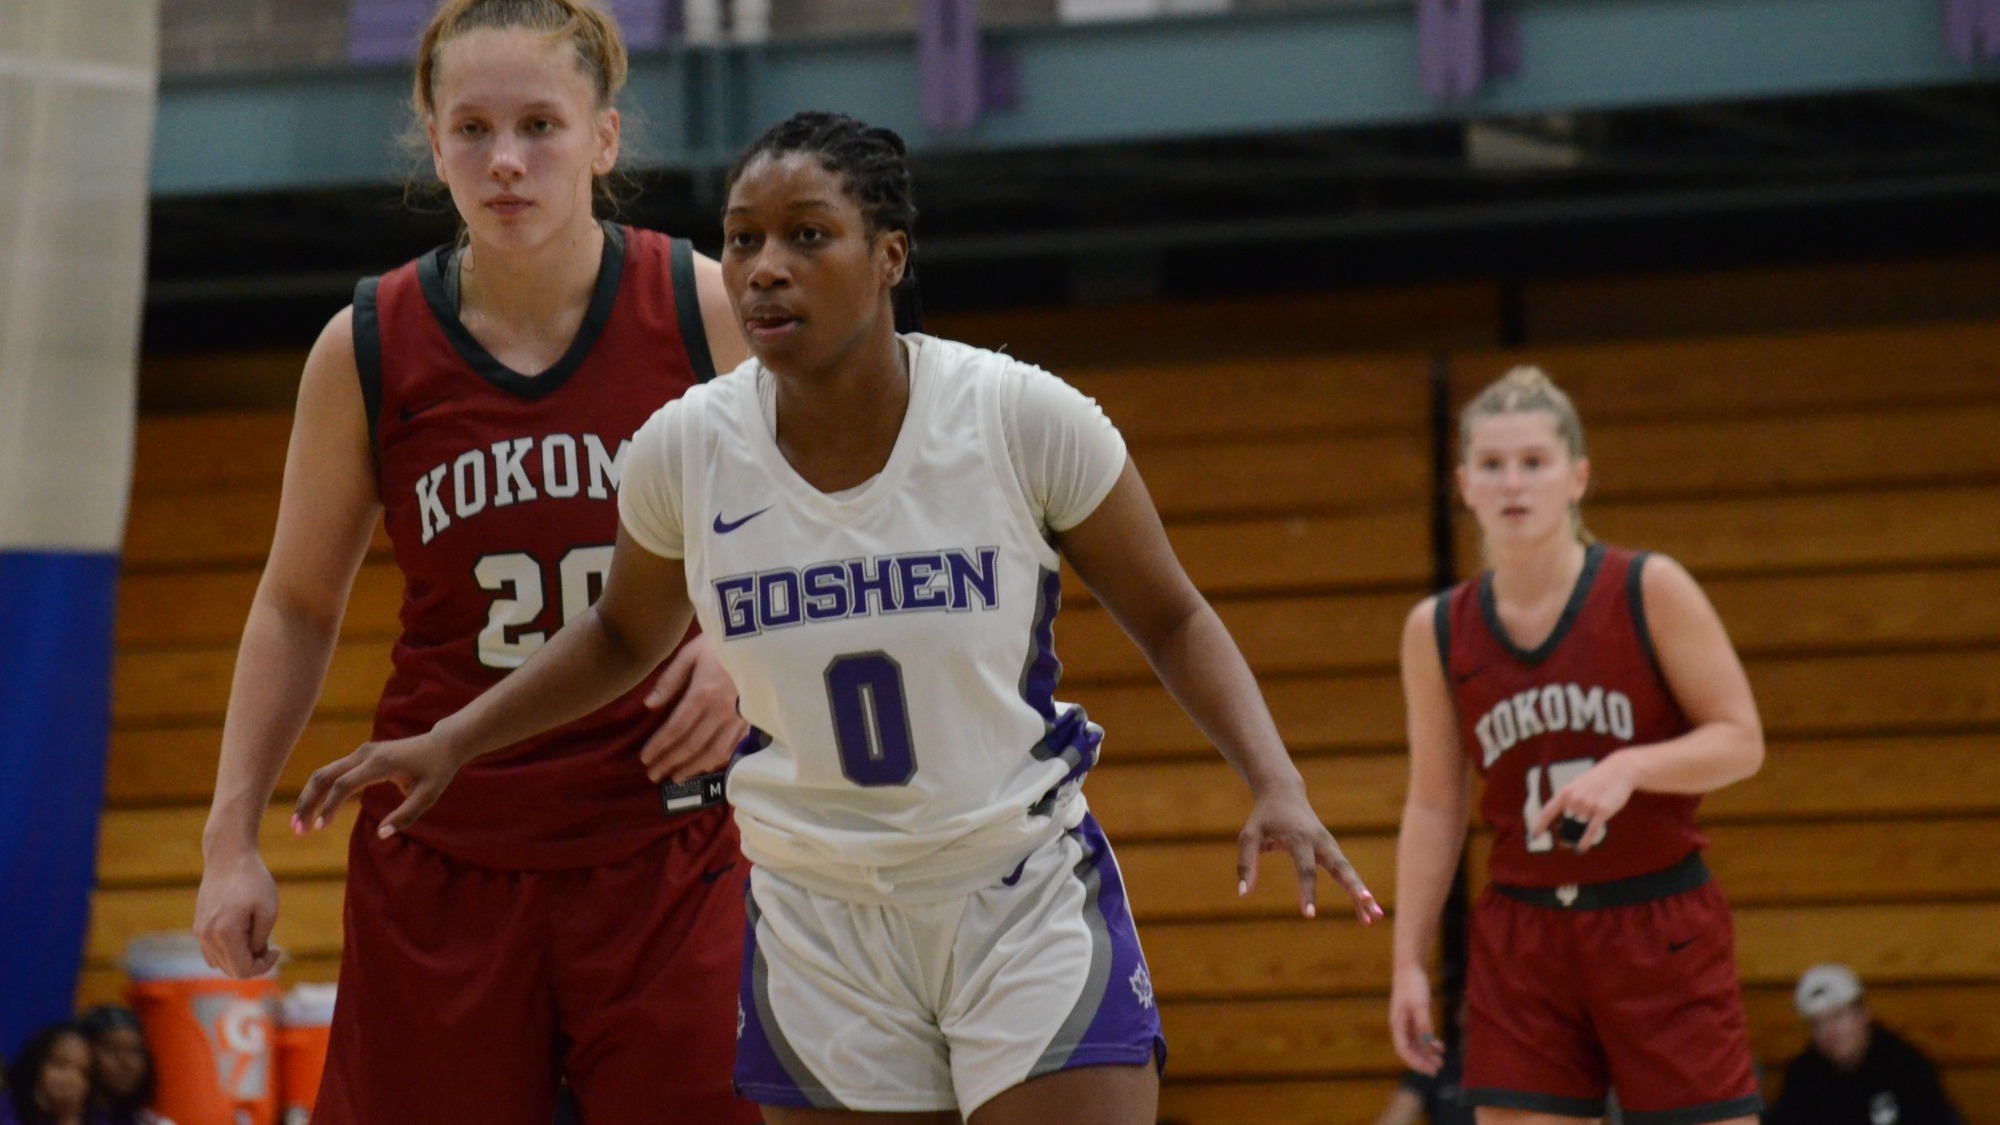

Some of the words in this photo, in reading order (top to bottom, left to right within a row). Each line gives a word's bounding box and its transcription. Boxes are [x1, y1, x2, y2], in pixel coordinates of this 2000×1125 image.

[415, 432, 633, 546] KOKOM
[711, 546, 1000, 641] GOSHEN
[822, 650, 918, 787] 0
[1475, 682, 1635, 769] KOKOMO
[709, 781, 722, 798] M
